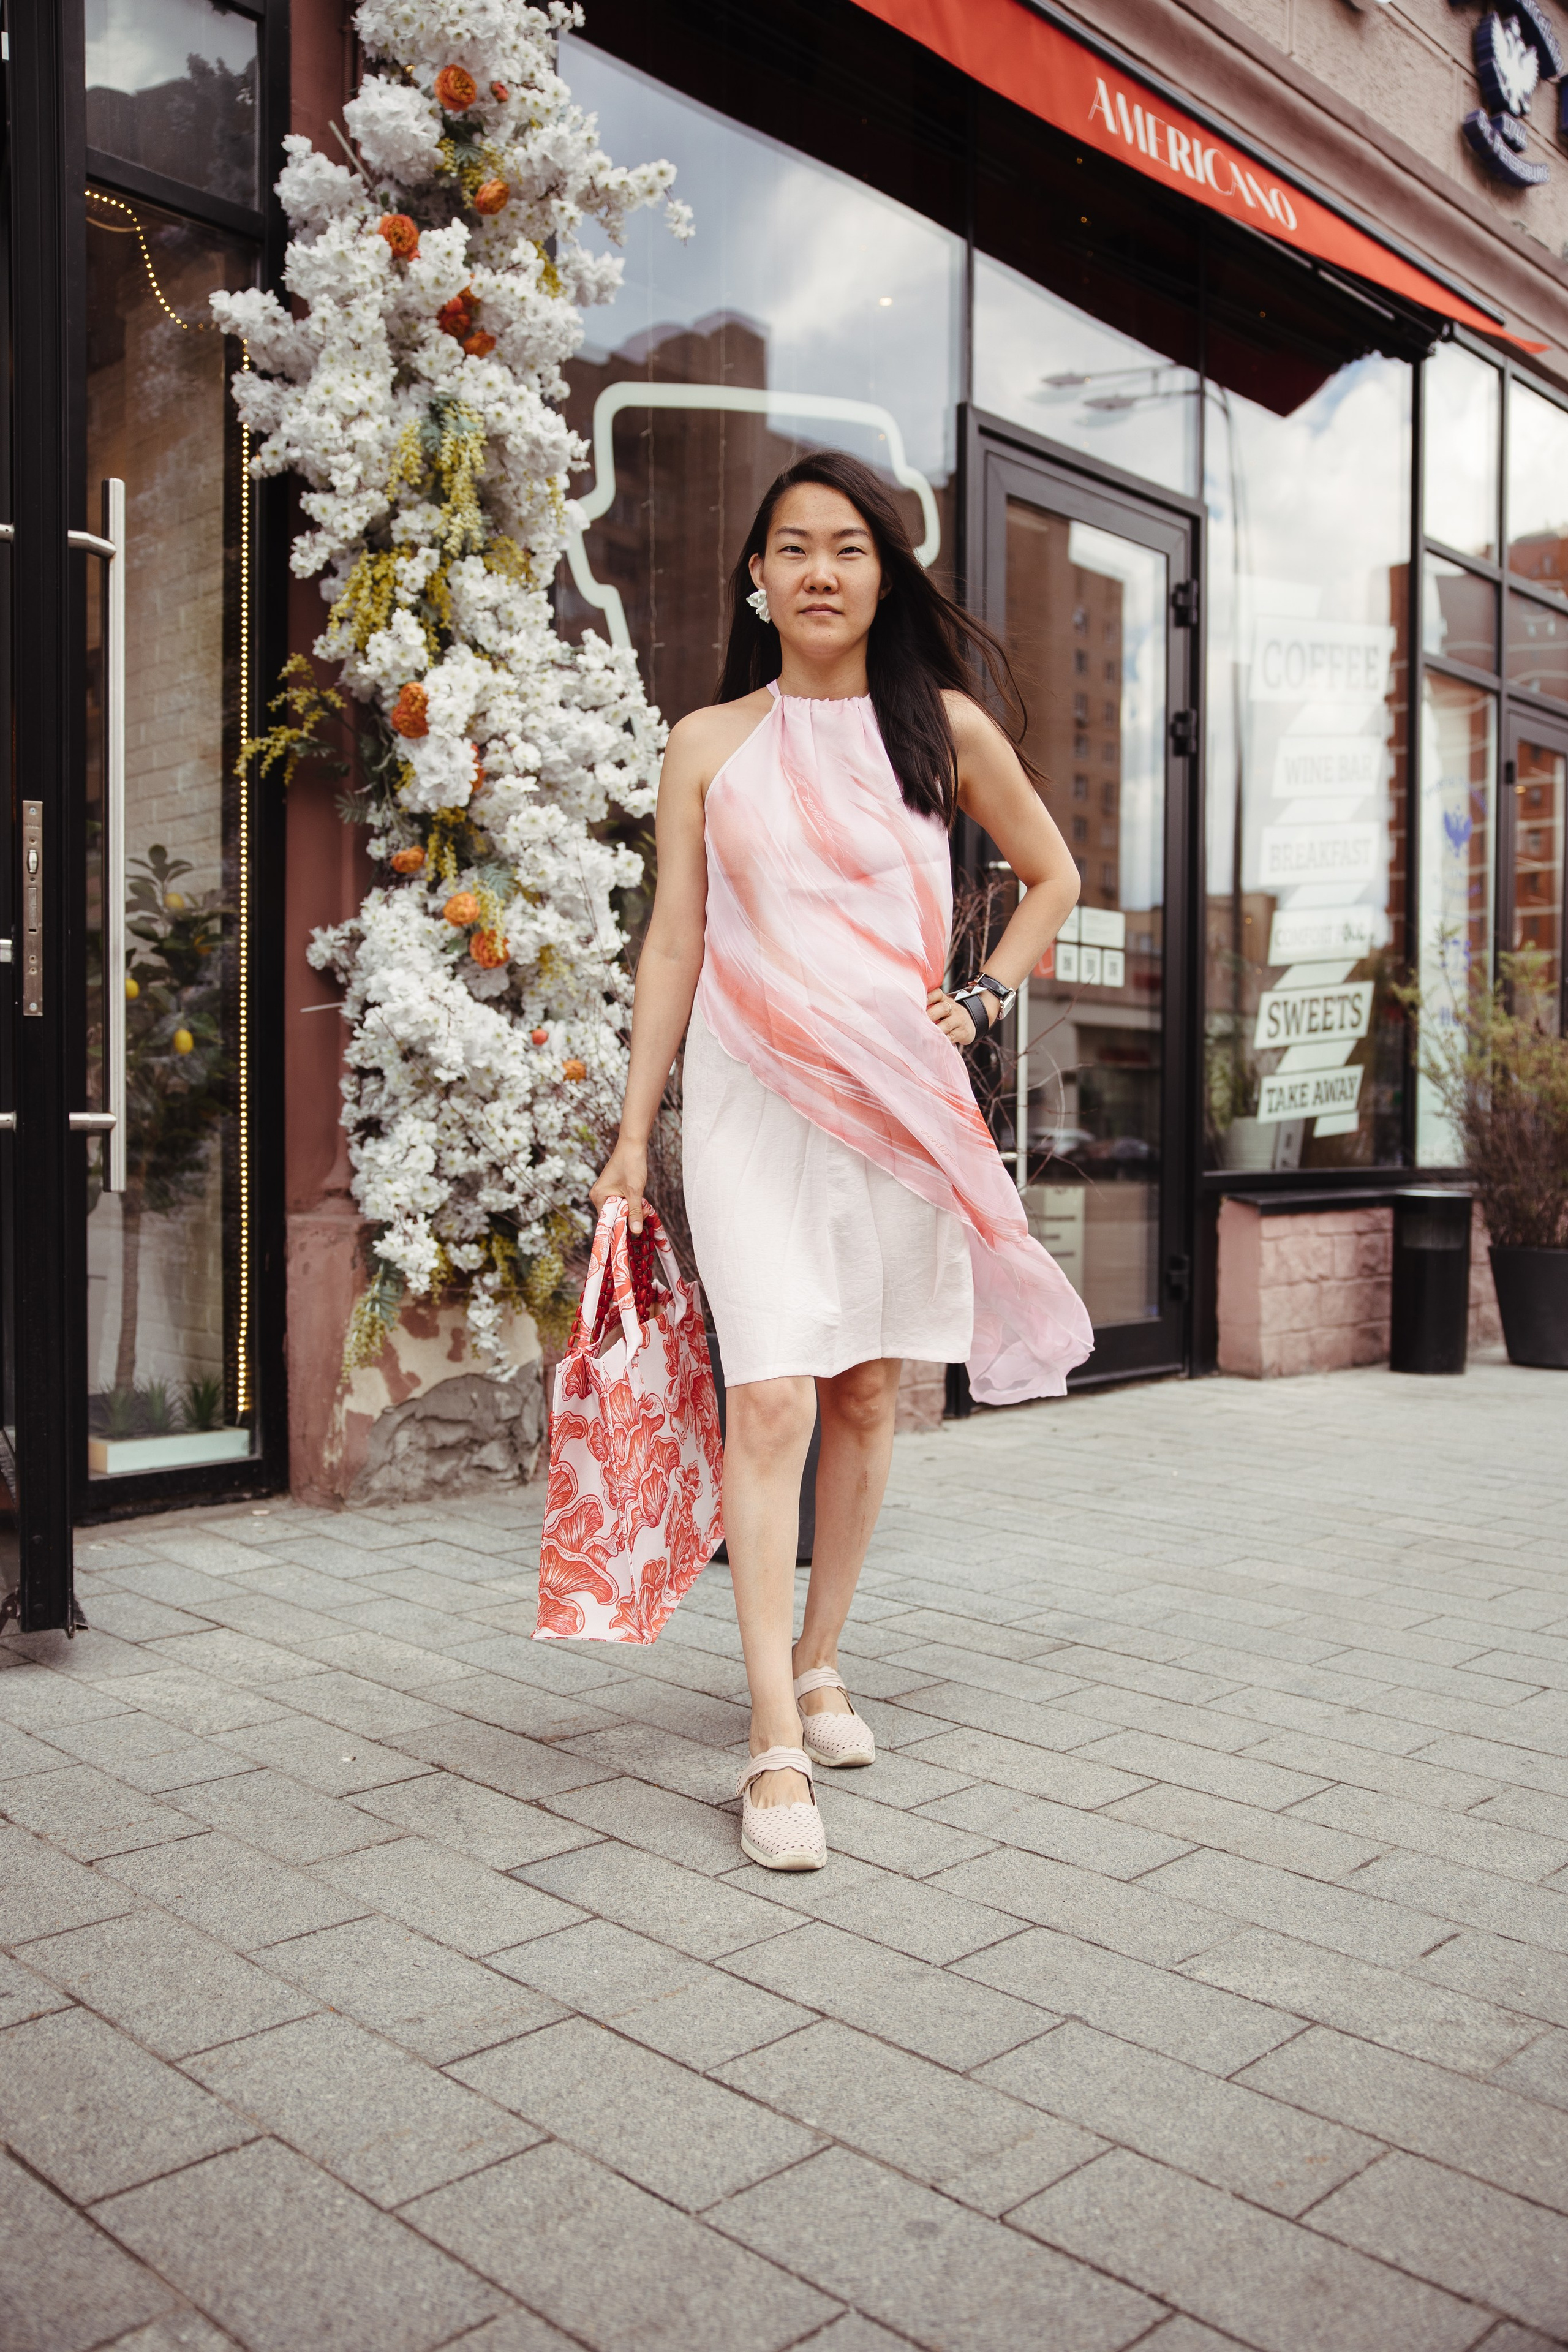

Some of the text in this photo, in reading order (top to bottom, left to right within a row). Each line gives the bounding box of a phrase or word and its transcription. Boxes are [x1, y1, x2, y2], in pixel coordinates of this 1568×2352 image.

[1088, 77, 1297, 231] AMERICANO
[1262, 638, 1379, 690] COFFEE
[1283, 752, 1373, 785] WINE BAR
[1269, 837, 1371, 873] BREAKFAST
[1267, 993, 1363, 1039] SWEETS
[1266, 1074, 1359, 1114] TAKE AWAY
